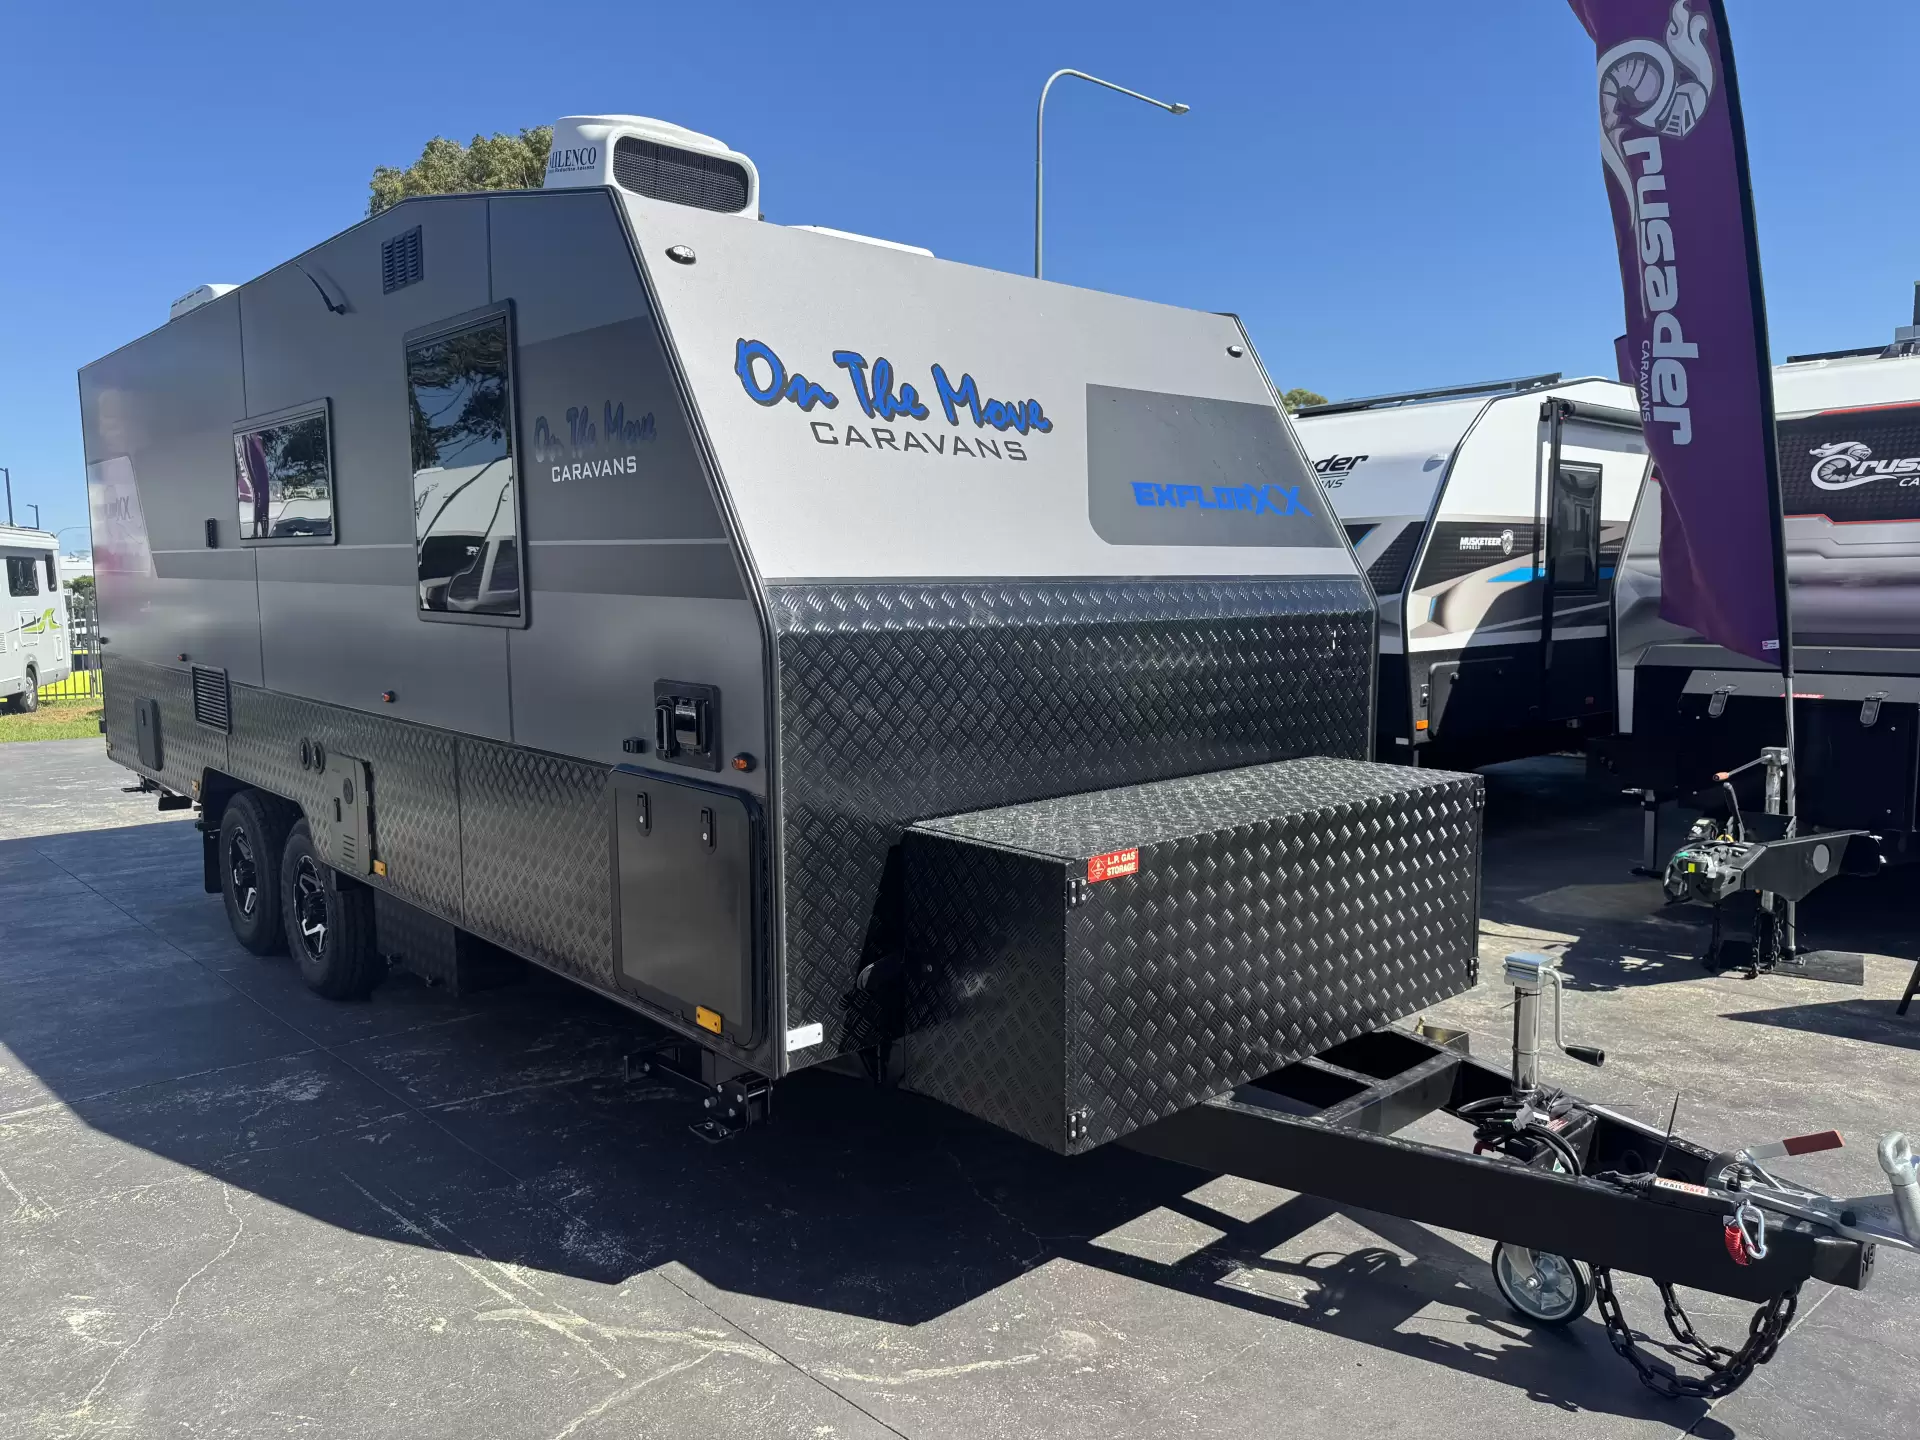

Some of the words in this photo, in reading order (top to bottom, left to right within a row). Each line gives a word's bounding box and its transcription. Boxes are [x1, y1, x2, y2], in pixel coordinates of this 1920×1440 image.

[734, 338, 839, 412] On
[832, 350, 930, 421] The
[930, 363, 1053, 435] Move
[1641, 339, 1651, 423] CARAVANS
[534, 415, 564, 462] On
[566, 405, 598, 459] The
[604, 399, 657, 449] Move
[810, 421, 1028, 462] CARAVANS
[551, 455, 637, 483] CARAVANS
[1311, 453, 1369, 473] der
[1809, 453, 1920, 491] Crus
[1130, 481, 1315, 517] EXPLORXX
[1321, 478, 1346, 489] NS
[1460, 536, 1501, 546] MUSKETEER
[1106, 861, 1136, 877] STORAGE
[1121, 851, 1136, 862] GAS
